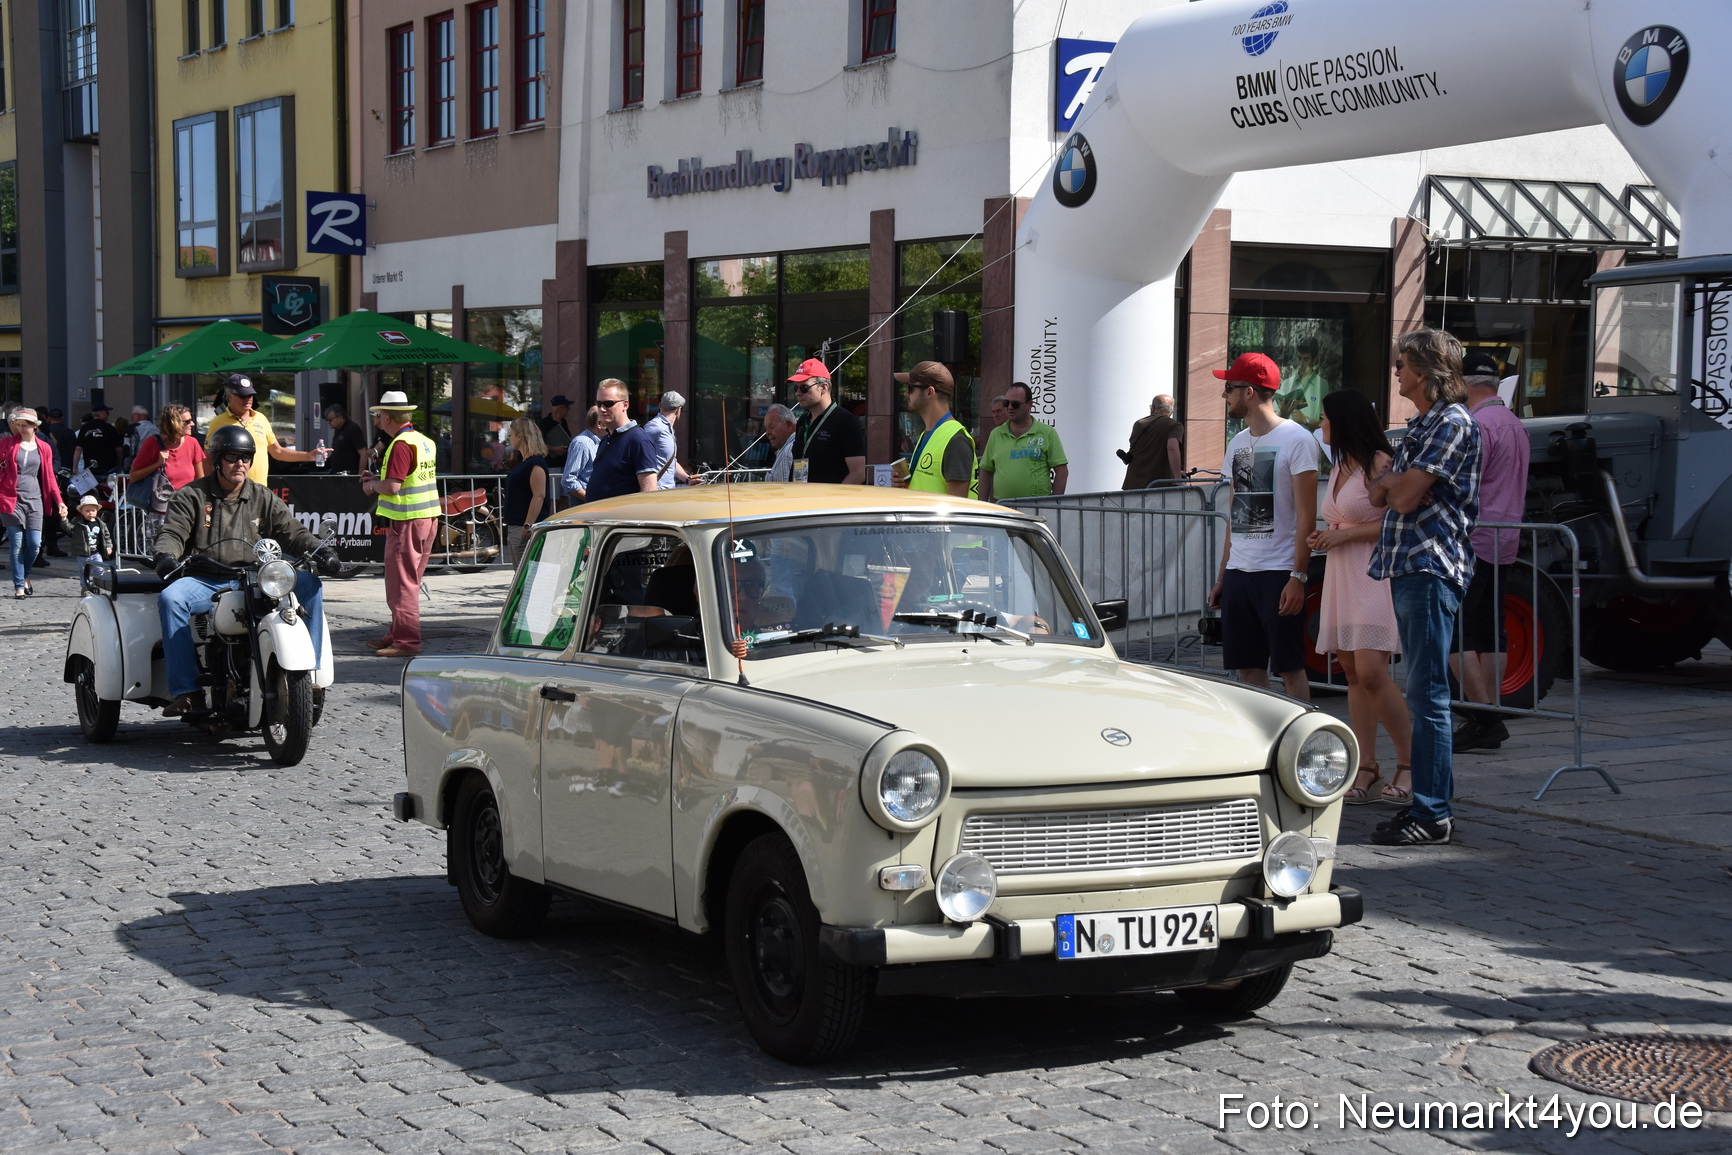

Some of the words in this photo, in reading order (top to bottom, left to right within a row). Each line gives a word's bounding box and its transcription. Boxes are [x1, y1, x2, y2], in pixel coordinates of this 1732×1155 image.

[1231, 24, 1246, 36] 100
[1246, 19, 1272, 33] YEARS
[1271, 14, 1295, 29] BMW
[1618, 27, 1686, 66] BMW
[1285, 61, 1322, 92] ONE
[1323, 46, 1404, 86] PASSION.
[1236, 70, 1277, 100] BMW
[1292, 92, 1333, 120] ONE
[1330, 71, 1448, 114] COMMUNITY.
[1230, 100, 1289, 129] CLUBS
[647, 149, 792, 199] Buchhandlung
[794, 126, 918, 187] Rupprecht
[386, 271, 398, 283] Markt
[398, 270, 404, 282] 15
[284, 292, 305, 316] G2
[1042, 316, 1058, 415] COMMUNITY.
[340, 537, 371, 549] Pyrbaum
[1062, 941, 1070, 951] D
[1076, 919, 1096, 953] N
[1118, 915, 1156, 950] TU
[1164, 911, 1215, 947] 924
